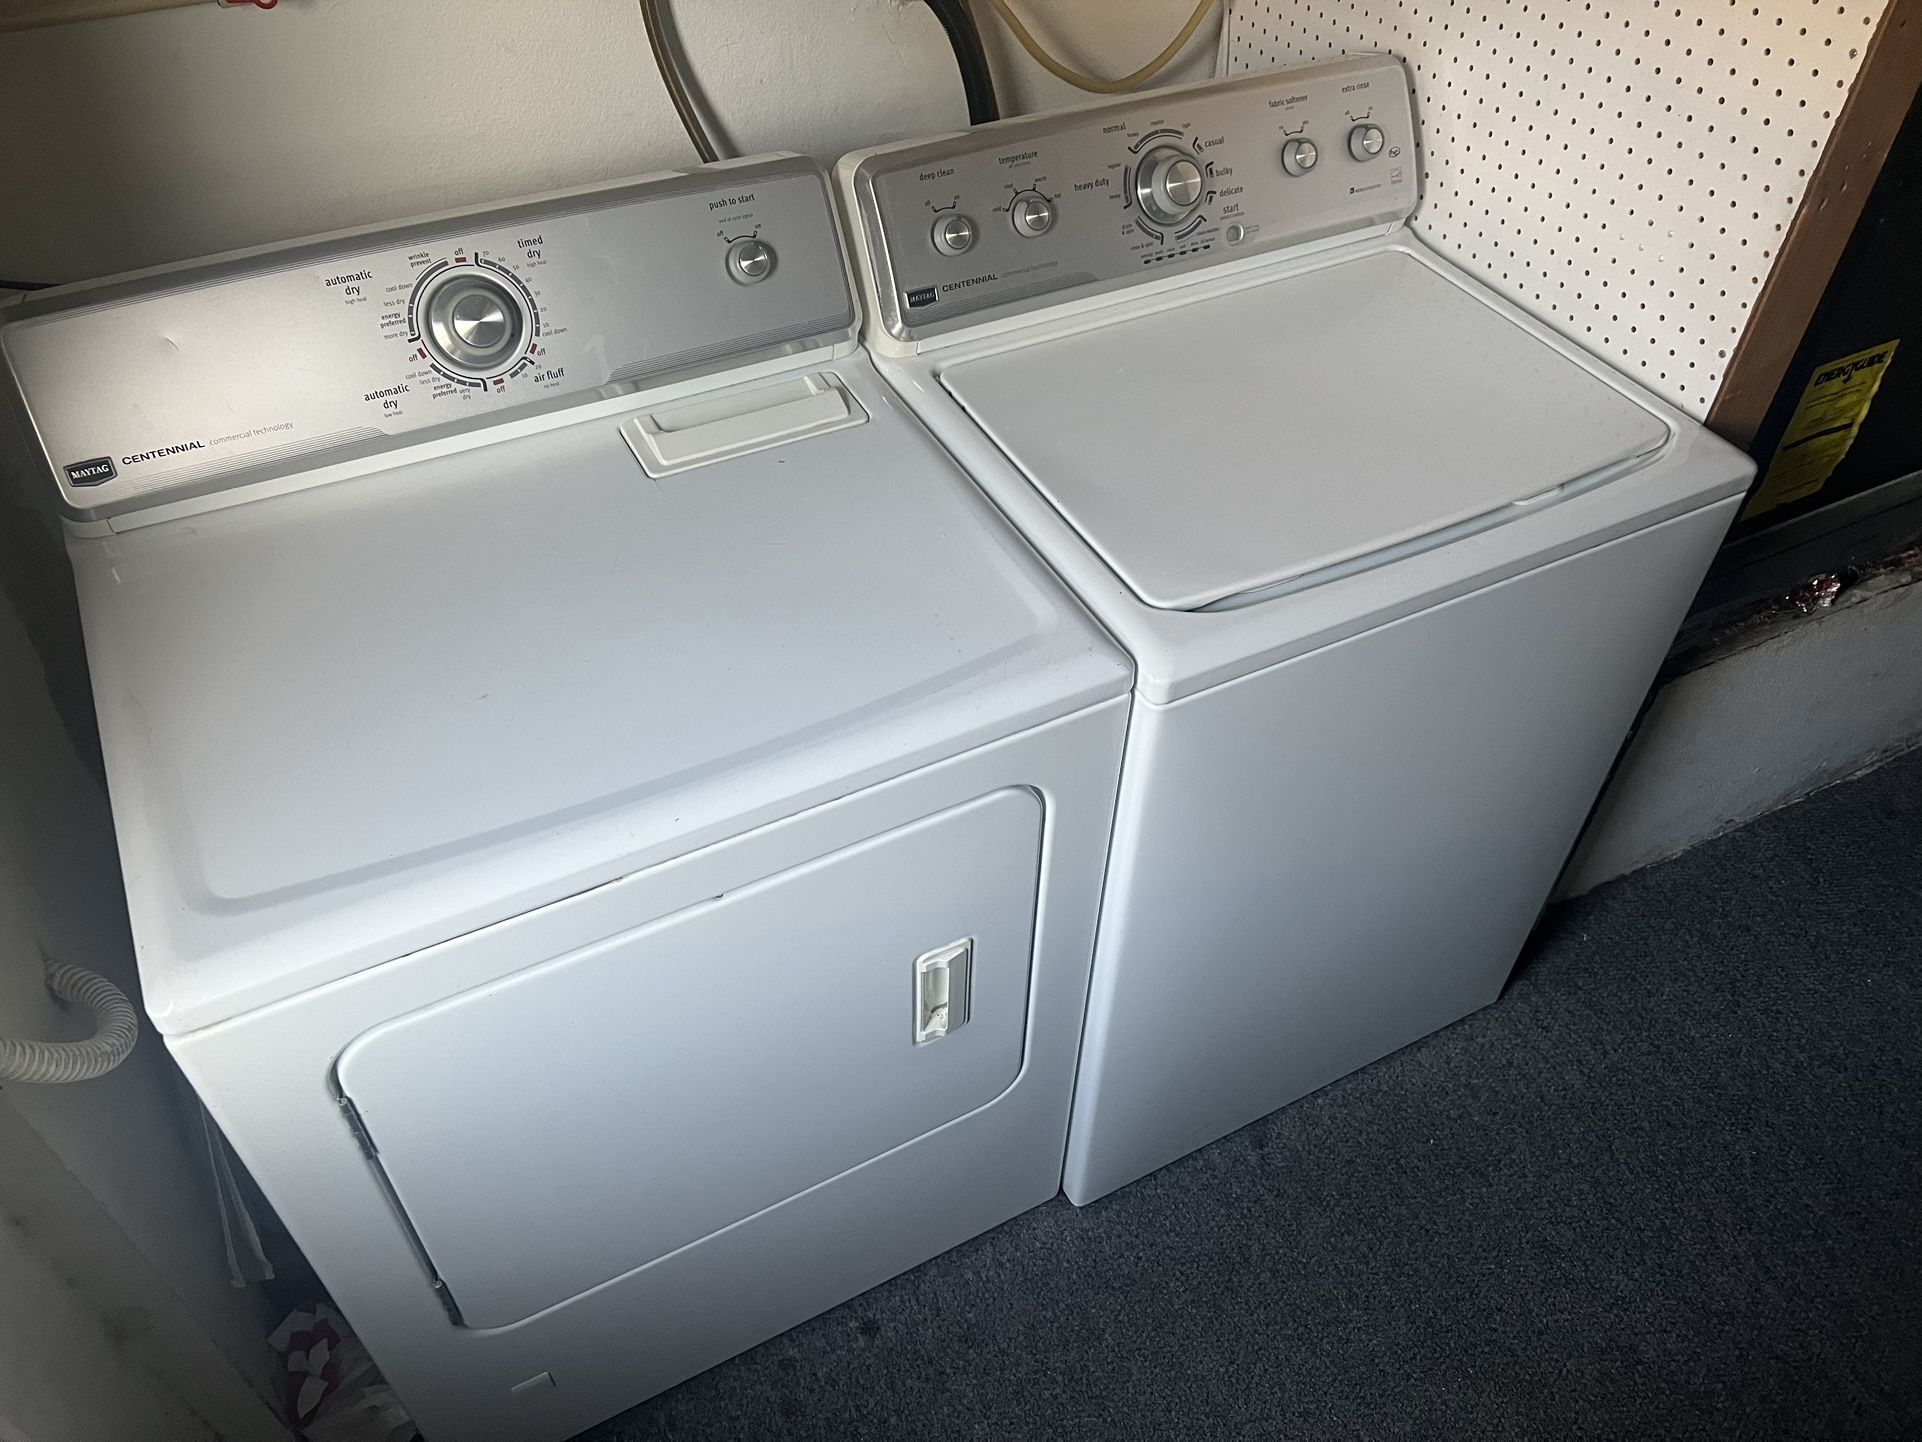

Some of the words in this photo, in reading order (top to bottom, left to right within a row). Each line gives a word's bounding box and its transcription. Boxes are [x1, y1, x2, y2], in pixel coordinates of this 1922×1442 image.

[1342, 83, 1356, 93] extra
[1269, 98, 1285, 108] fabric
[1286, 95, 1308, 104] softener
[1103, 123, 1126, 134] normal
[1204, 136, 1225, 148] casual
[999, 150, 1038, 165] temperature
[919, 171, 936, 182] deep
[937, 168, 955, 177] clean
[1215, 166, 1233, 177] bulky
[1074, 181, 1093, 191] heavy
[1095, 178, 1109, 187] duty
[1219, 185, 1243, 197] delicate
[709, 198, 727, 211] push
[728, 197, 736, 205] to
[738, 193, 755, 203] start
[1223, 203, 1239, 214] start
[517, 235, 543, 248] timed
[408, 251, 429, 260] wrinkle
[454, 247, 464, 255] off
[527, 249, 541, 259] dry
[410, 258, 432, 268] prevent
[325, 270, 373, 286] automatic
[910, 292, 935, 303] MAYTAG
[942, 274, 998, 292] CENTENNIAL
[1030, 261, 1058, 272] technology
[345, 286, 360, 296] dry
[398, 283, 413, 291] down
[381, 312, 401, 320] energy
[380, 318, 406, 329] preferred
[537, 348, 546, 356] off
[408, 354, 418, 363] off
[405, 372, 416, 380] cool
[417, 369, 432, 377] down
[534, 373, 545, 383] air
[546, 368, 565, 380] fluff
[364, 383, 410, 401] automatic
[434, 382, 452, 391] energy
[496, 385, 506, 393] off
[432, 388, 457, 399] preferred
[383, 399, 398, 409] dry
[71, 464, 110, 480] MAYTAG
[122, 440, 206, 466] CENTENNIAL
[209, 429, 252, 447] commercial
[253, 420, 294, 437] technology
